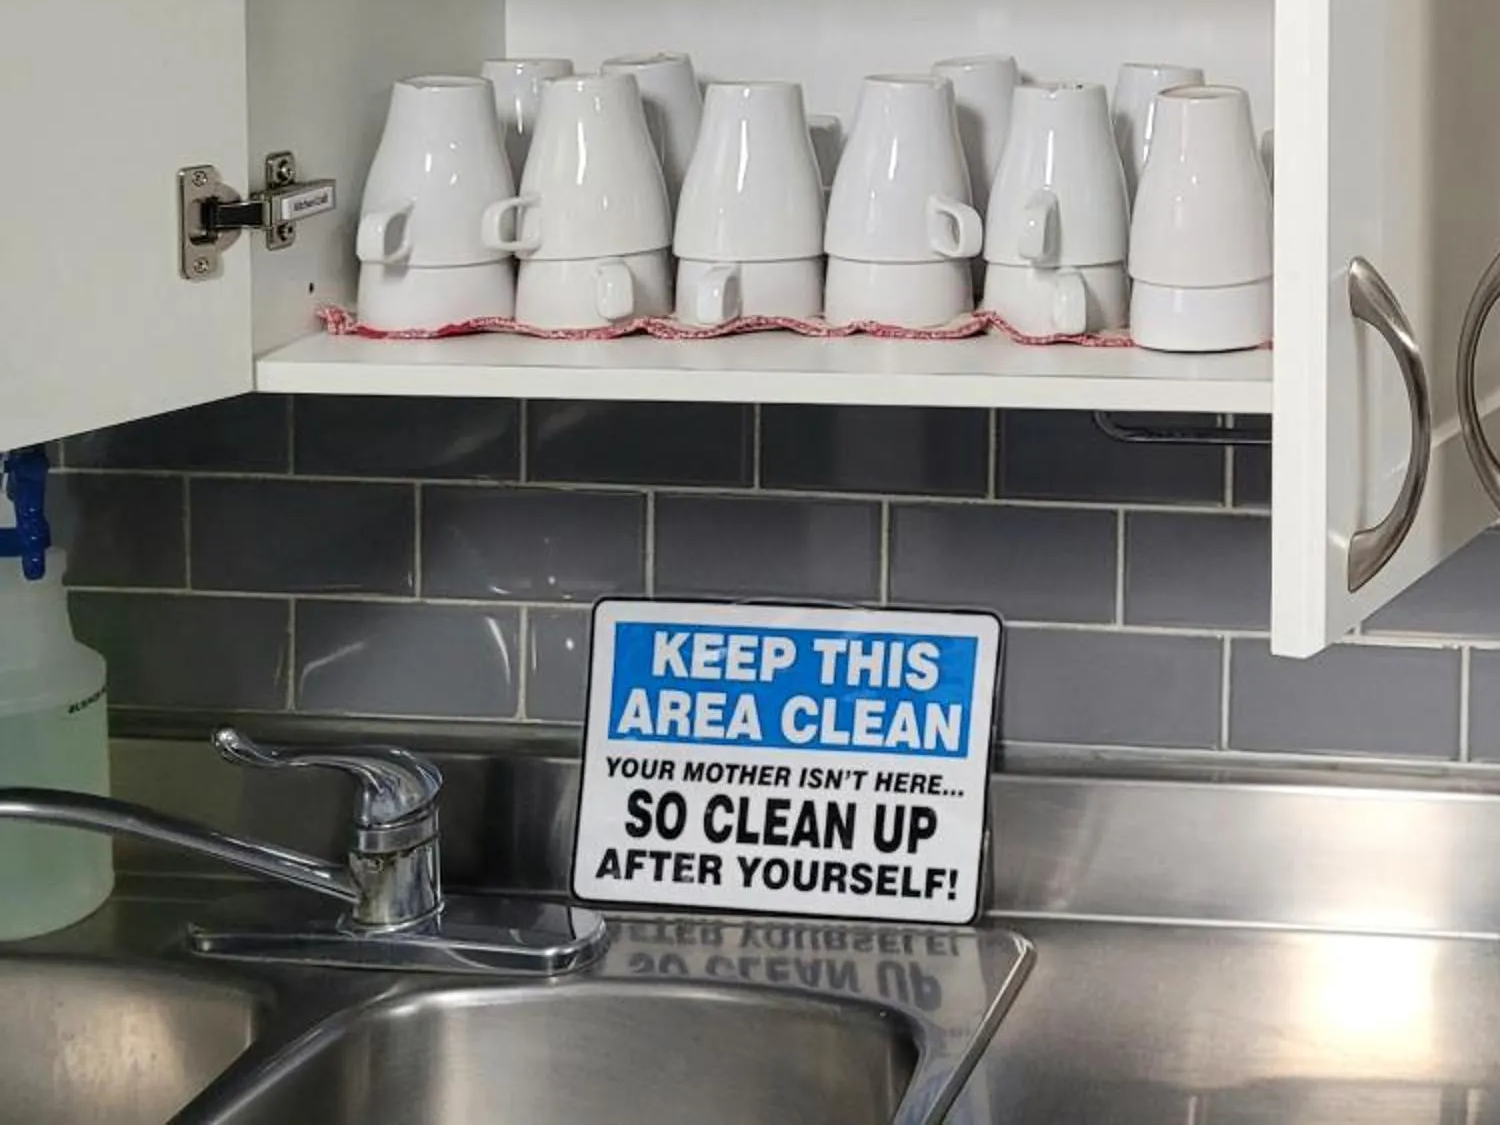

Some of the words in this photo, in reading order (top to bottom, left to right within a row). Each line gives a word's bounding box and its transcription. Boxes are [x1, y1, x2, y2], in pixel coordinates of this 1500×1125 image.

[652, 631, 797, 682] KEEP
[813, 638, 940, 691] THIS
[617, 688, 762, 741] AREA
[781, 696, 963, 752] CLEAN
[606, 757, 675, 780] YOUR
[683, 762, 791, 787] MOTHER
[799, 767, 867, 791] ISN'T
[874, 771, 965, 797] HERE...
[625, 789, 687, 840] SO
[703, 794, 856, 850] CLEAN
[873, 803, 938, 854] UP
[595, 848, 722, 885] AFTER
[737, 856, 959, 900] YOURSELF!
